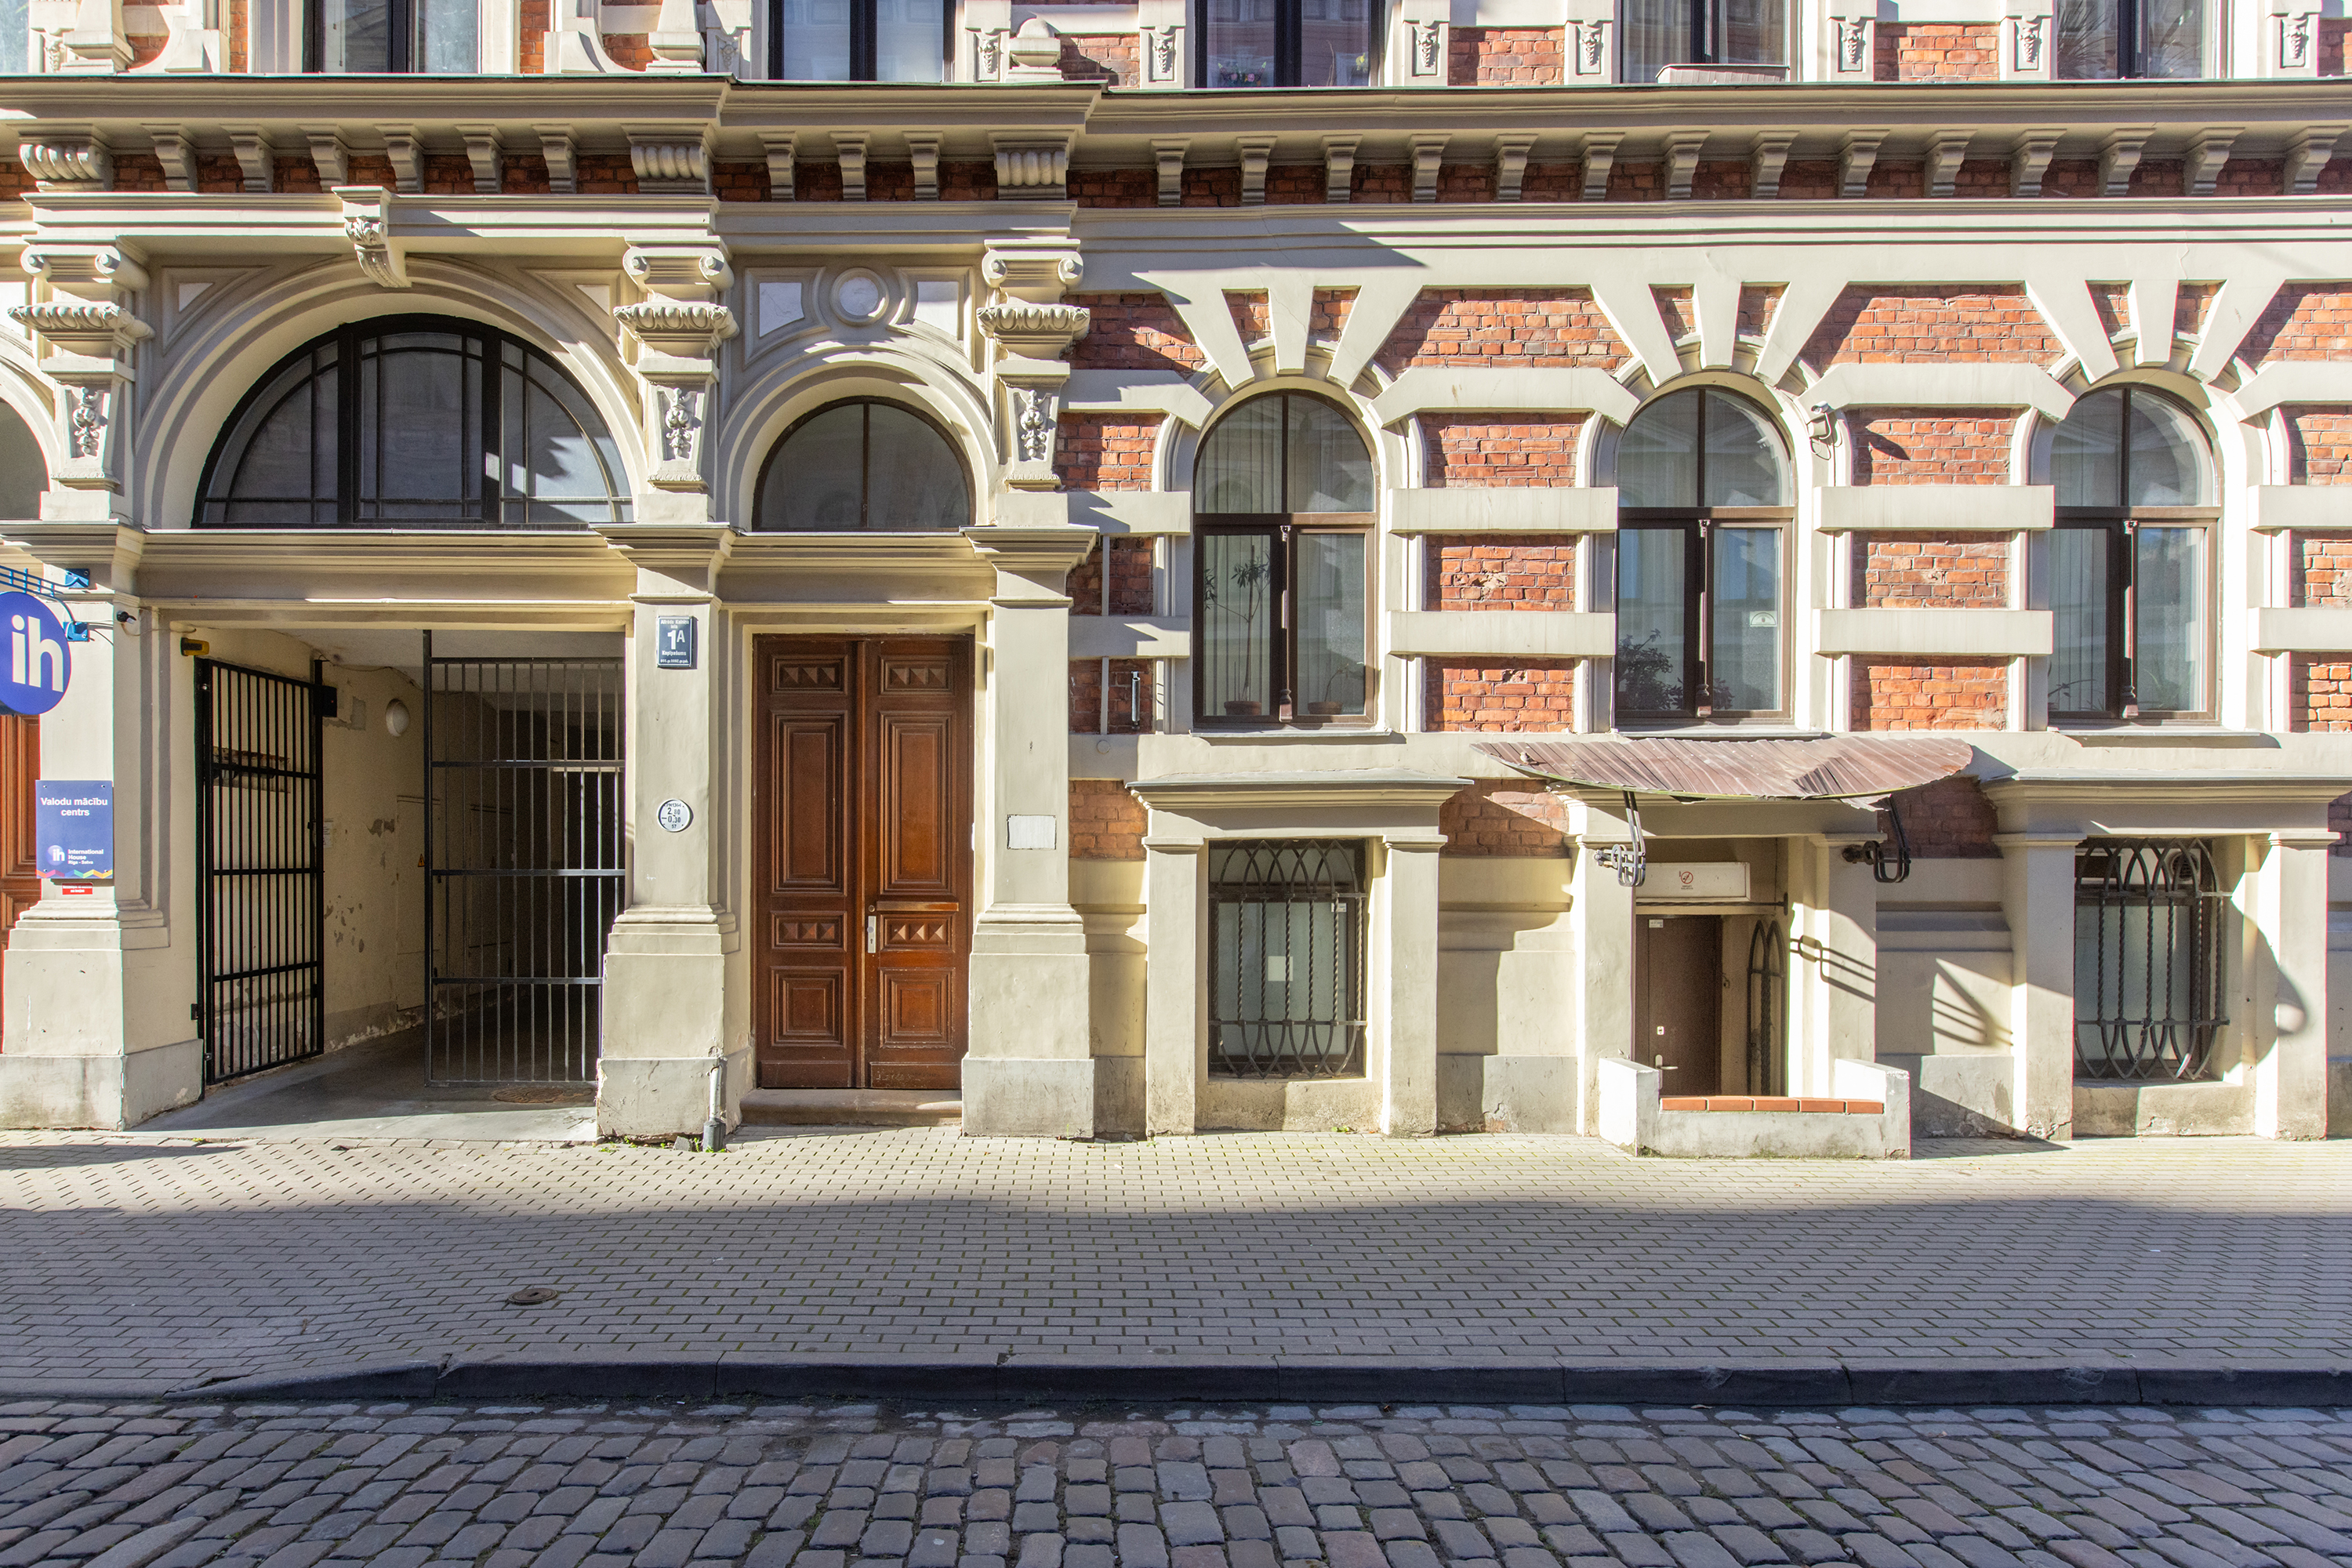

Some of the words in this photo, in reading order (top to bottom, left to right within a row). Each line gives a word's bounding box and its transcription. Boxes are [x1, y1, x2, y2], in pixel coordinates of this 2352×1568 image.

[667, 630, 685, 649] 1A
[12, 615, 64, 692] ih
[40, 797, 72, 806] Valodu
[74, 797, 108, 806] mācību
[53, 848, 65, 862] ih
